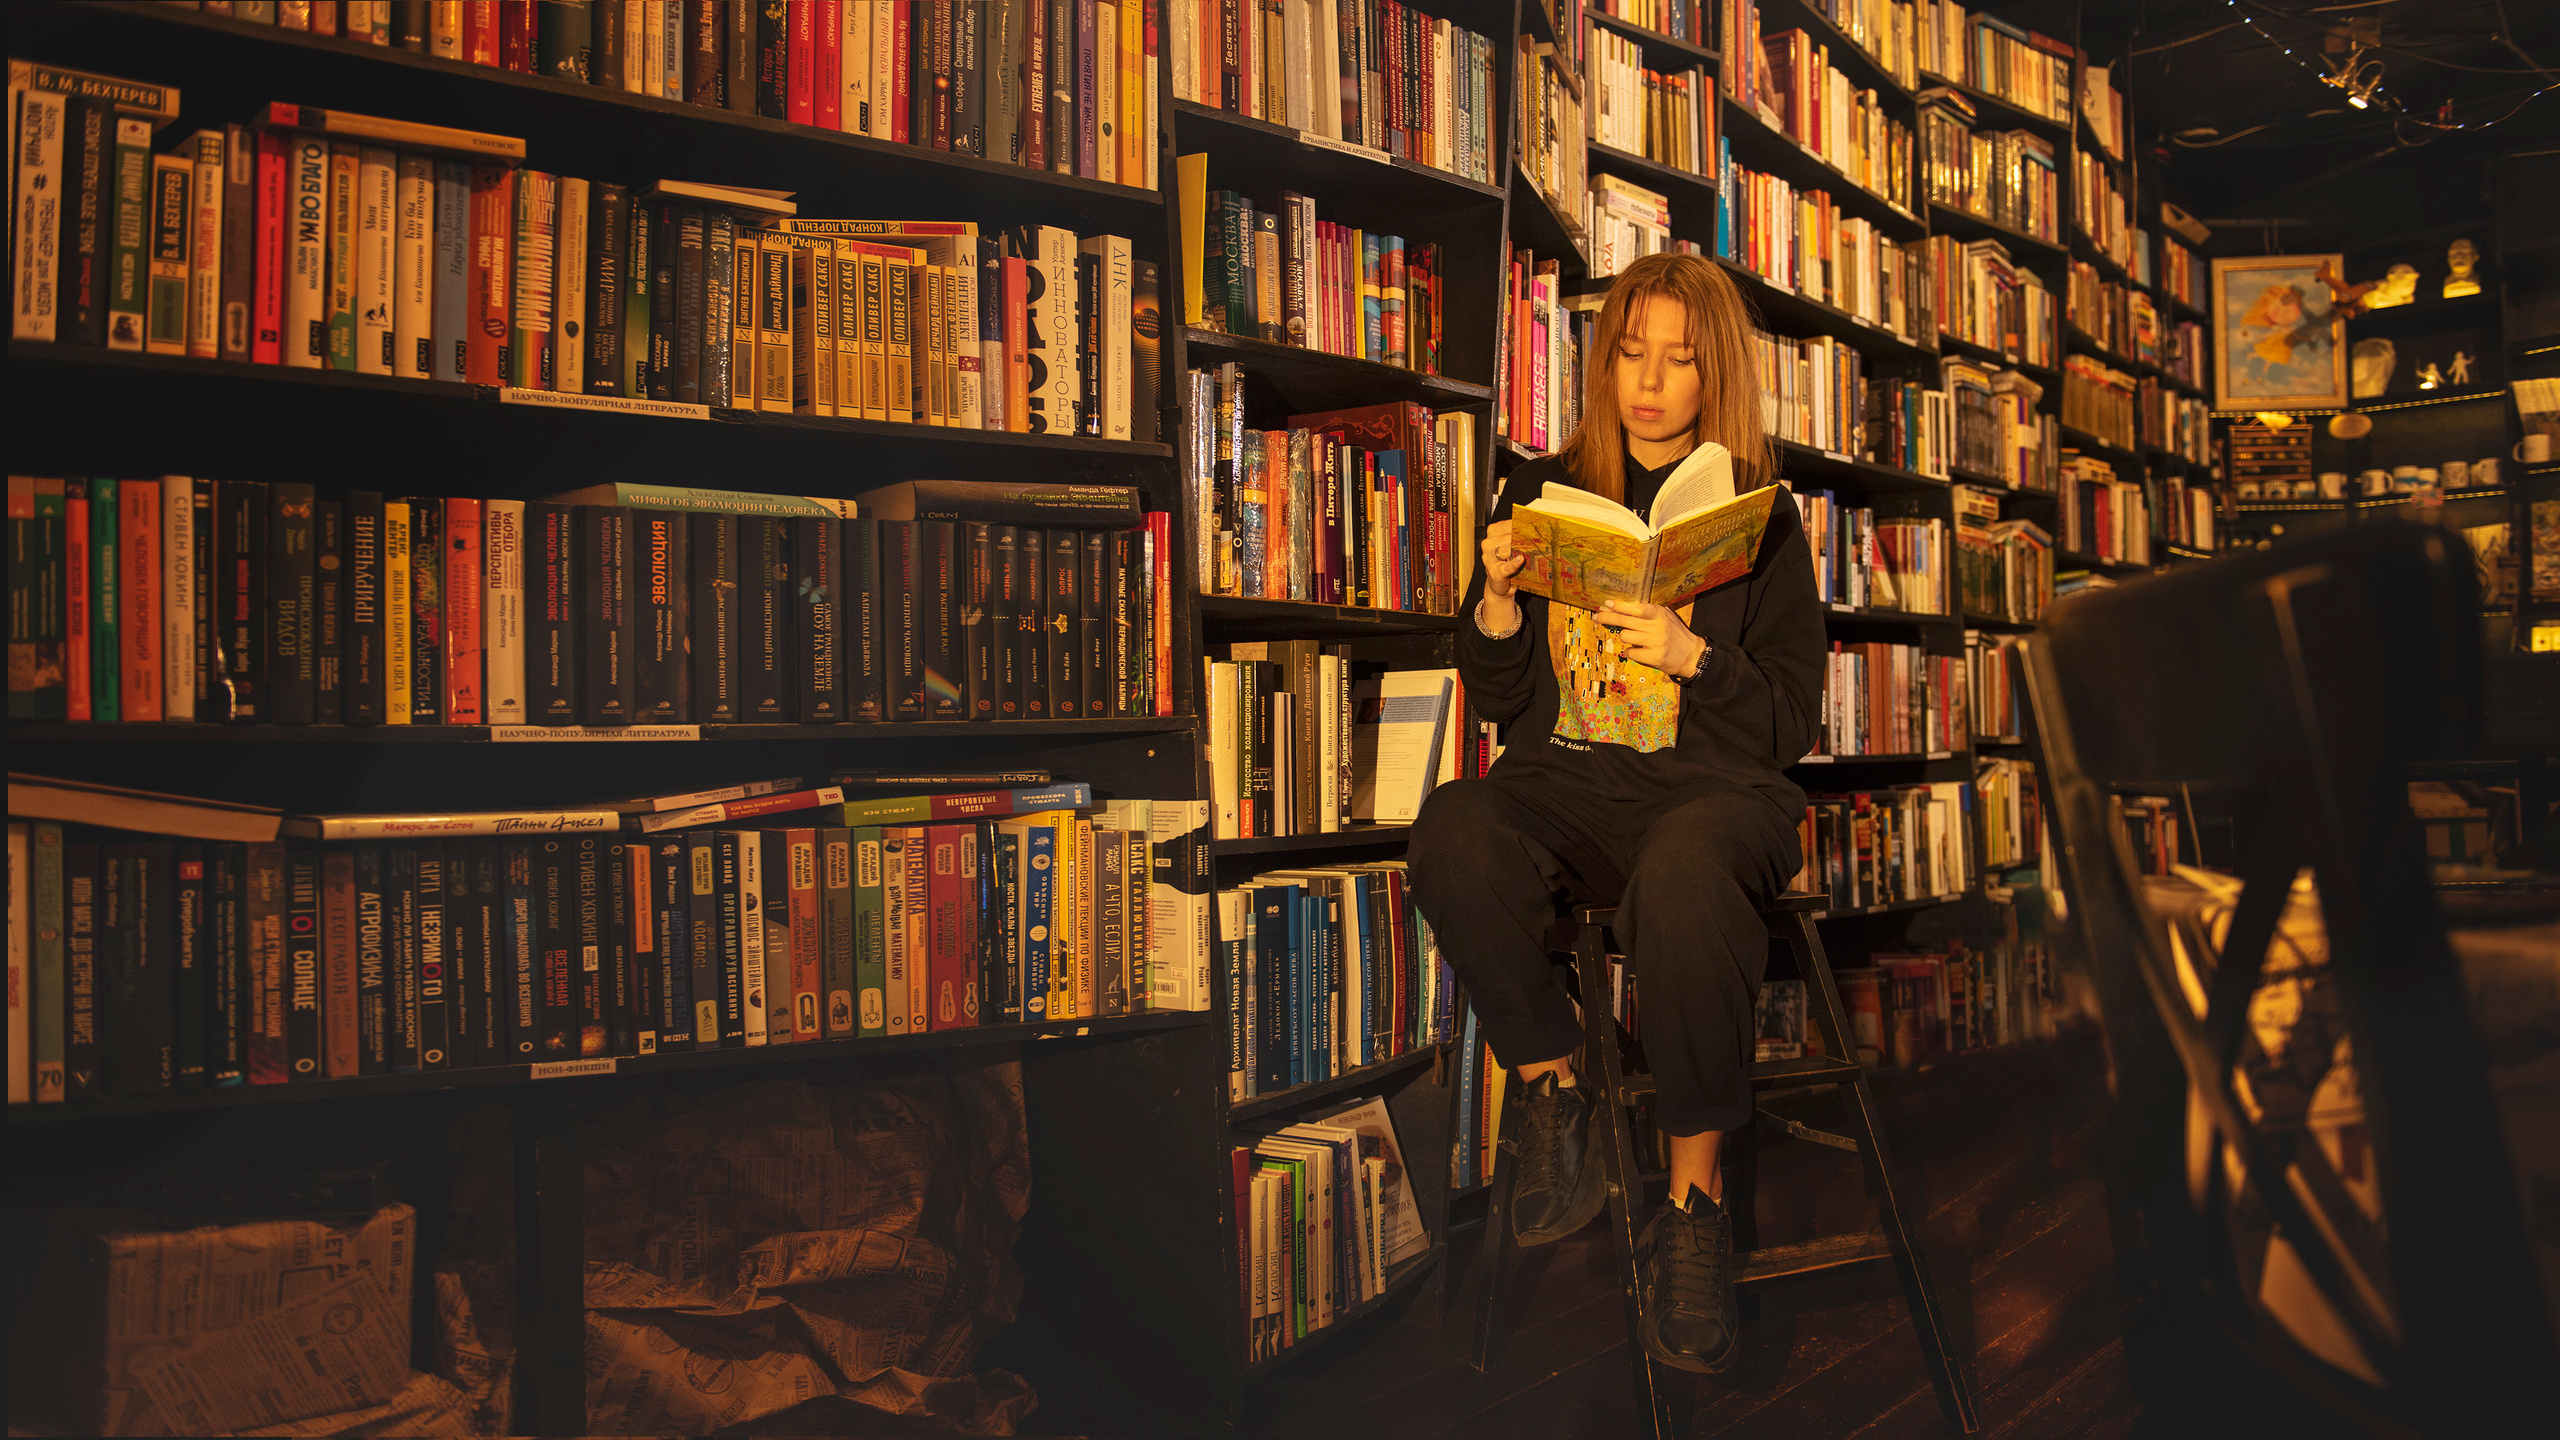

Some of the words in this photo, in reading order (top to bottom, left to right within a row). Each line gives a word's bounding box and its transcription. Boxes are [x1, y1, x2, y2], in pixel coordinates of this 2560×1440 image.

[966, 9, 976, 34] выбор
[879, 18, 889, 75] МОРАЛЬНЫЙ
[954, 21, 966, 68] Смертельно
[965, 36, 975, 70] опасный
[1034, 37, 1042, 60] ПРЕДЕЛЕ
[39, 72, 54, 87] В.
[58, 76, 78, 92] М.
[82, 80, 158, 106] БЕХТЕРЕВ
[880, 79, 888, 107] ХАРРИС
[956, 72, 965, 98] Оффит
[1032, 72, 1044, 113] EXTREMES
[24, 101, 44, 167] МОГУЧИЙ
[301, 144, 322, 193] БЛАГО
[162, 172, 186, 228] БЕХТЕРЕВ
[300, 196, 321, 220] ВО
[161, 231, 183, 245] М.
[298, 223, 319, 243] УМ
[681, 217, 703, 249] САКС
[797, 220, 840, 233] ЛОРЕНЦ
[841, 222, 883, 233] КОНРАД
[161, 247, 183, 259] В.
[478, 236, 492, 268] СУММА
[1113, 246, 1127, 289] ДНК
[1223, 215, 1240, 287] МОСКВА
[491, 237, 506, 307] БИОТЕХНОЛОГИИ
[515, 231, 553, 333] ОРИГИНАЛЫ
[600, 257, 615, 291] МИР
[740, 252, 751, 295] БЖЕЗИНСКИЙ
[768, 254, 782, 300] ДАЙМОНД
[816, 260, 829, 288] САКС
[841, 264, 853, 291] САКС
[866, 267, 878, 293] САКС
[892, 270, 904, 295] САКС
[740, 296, 749, 325] ЗБИГНЕВ
[817, 290, 830, 333] ОЛИВЕР
[842, 293, 854, 336] ОЛИВЕР
[929, 277, 940, 316] ФЕЙНМАН
[959, 275, 970, 342] ИНТЕЛЛЕКТ
[772, 301, 783, 329] ДЖАРЕД
[867, 296, 879, 338] ОЛИВЕР
[894, 298, 906, 340] ОЛИВЕР
[931, 317, 940, 347] РИЧАРД
[654, 334, 662, 372] АЛЕССАНДРО
[662, 340, 670, 367] БАРИККО
[1053, 266, 1070, 429] ИННОВАТОРЫ
[511, 391, 631, 410] НАУЧНО-ПОПУЛЯРНАЯ
[634, 402, 698, 416] ЛИТЕРАТУРА
[1325, 441, 1335, 474] Жить
[629, 495, 668, 506] МИФЫ
[673, 497, 690, 507] ОБ
[692, 499, 763, 512] ЭВОЛЮЦИИ
[765, 503, 827, 516] ЧЕЛОВЕКА
[1326, 476, 1336, 518] Питере
[174, 496, 188, 550] СТИВЕН
[388, 520, 397, 559] ВЕНТЕР
[397, 523, 407, 556] КРЕЙГ
[503, 511, 514, 552] ОТБОРА
[547, 513, 558, 563] ЧЕЛОВЕКА
[490, 510, 503, 589] ПЕРСПЕКТИВЫ
[652, 520, 667, 605] ЭВОЛЮЦИЯ
[175, 554, 188, 611] ХОКИНГ
[354, 515, 375, 623] ПРИРУЧЕНИЕ
[416, 543, 430, 613] СТРУКТУРА
[548, 564, 559, 621] ЭВОЛЮЦИЯ
[903, 593, 911, 627] СЛЕПОЙ
[276, 599, 296, 656] ВИДОВ
[299, 575, 313, 681] ПРОИСХОЖДЕНИЕ
[764, 590, 773, 653] ЭГОИСТИЧНЫЙ
[814, 603, 825, 631] ШОУ
[416, 617, 431, 701] РЕАЛЬНОСТИ
[814, 634, 824, 650] НА
[765, 655, 773, 671] ГЕН
[814, 655, 824, 691] ЗЕМЛЕ
[1303, 653, 1312, 672] Руси
[1341, 659, 1349, 679] книги
[1243, 665, 1253, 750] коллекционирования
[1303, 674, 1312, 709] Древней
[499, 730, 624, 739] НАУЧНО-ПОПУЛЯРНАЯ
[1304, 718, 1312, 741] Книга
[1326, 735, 1334, 755] Книга
[1340, 713, 1350, 767] Художественная
[1549, 736, 1566, 747] The
[1566, 741, 1584, 752] kiss
[1243, 754, 1253, 797] Искусство
[1326, 775, 1335, 808] Петроски
[946, 795, 997, 806] НЕВЕРОЯТНЫЕ
[960, 805, 984, 813] ЧИСЛА
[579, 851, 596, 897] СТИВЕН
[908, 837, 925, 915] МАТЕМАТИКА
[1078, 826, 1090, 902] ФЕЙНМАНОВСКИЕ
[1130, 843, 1144, 874] САКС
[420, 861, 440, 893] КАРТА
[582, 899, 597, 945] ХОКИНГ
[1078, 905, 1090, 941] ЛЕКЦИИ
[1102, 895, 1120, 921] ЧТО,
[359, 892, 383, 988] АСТРОФИЗИКА
[747, 913, 762, 942] КОСМОС
[1133, 881, 1144, 985] ГАЛЛЮЦИНАЦИИ
[421, 911, 443, 996] НЕЗРИМОГО
[748, 945, 762, 989] ЭЙНШТЕЙНА
[1079, 943, 1090, 955] ПО
[1230, 941, 1241, 975] Земля
[291, 950, 315, 1011] СОЛНЦЕ
[554, 949, 569, 1006] ВСЕЛЕННАЯ
[1080, 958, 1090, 994] ФИЗИКЕ
[1230, 977, 1240, 1011] Новая
[1230, 1012, 1241, 1070] Архипелаг
[538, 1063, 610, 1075] НОН-ФИКШН
[1464, 1038, 1472, 1089] BELIEVE
